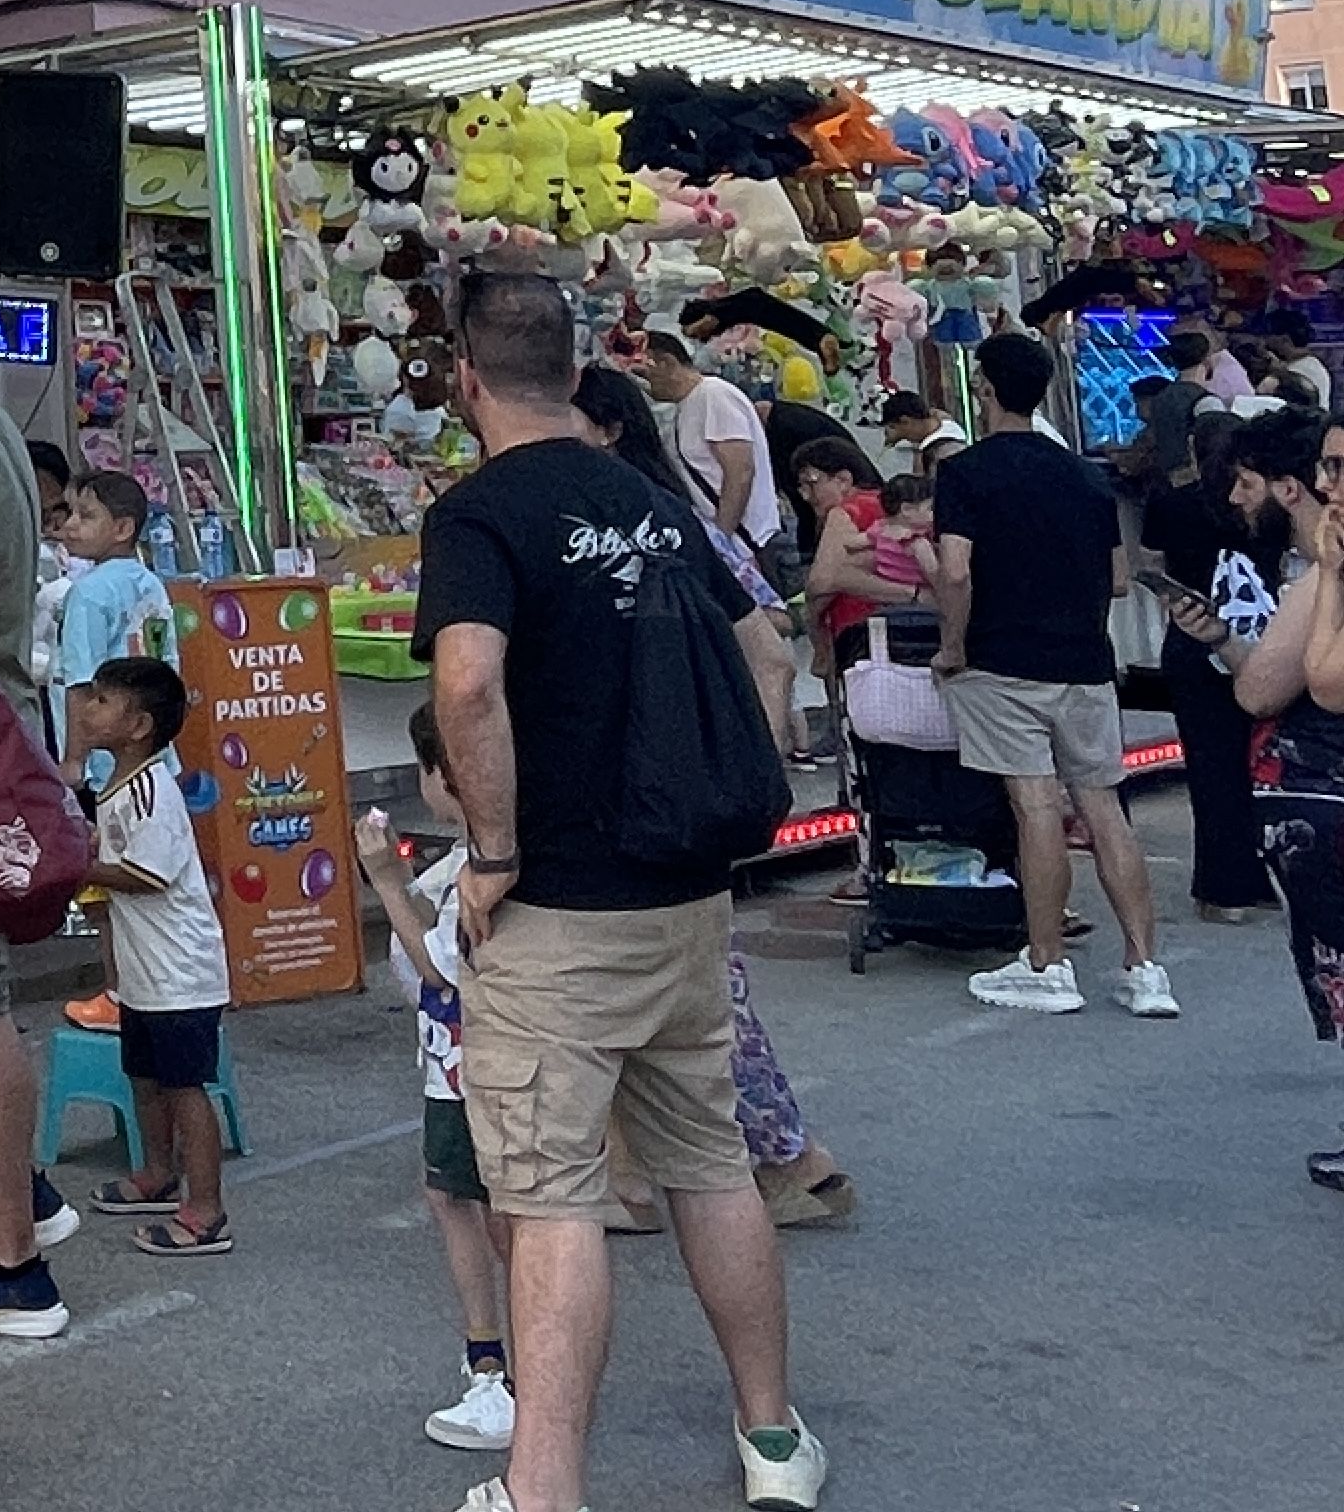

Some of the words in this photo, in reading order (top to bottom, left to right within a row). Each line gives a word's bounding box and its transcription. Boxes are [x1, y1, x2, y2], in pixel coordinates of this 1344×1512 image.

[228, 644, 304, 670] VENTA
[252, 670, 285, 693] DE
[215, 691, 327, 723] PARTIDAS
